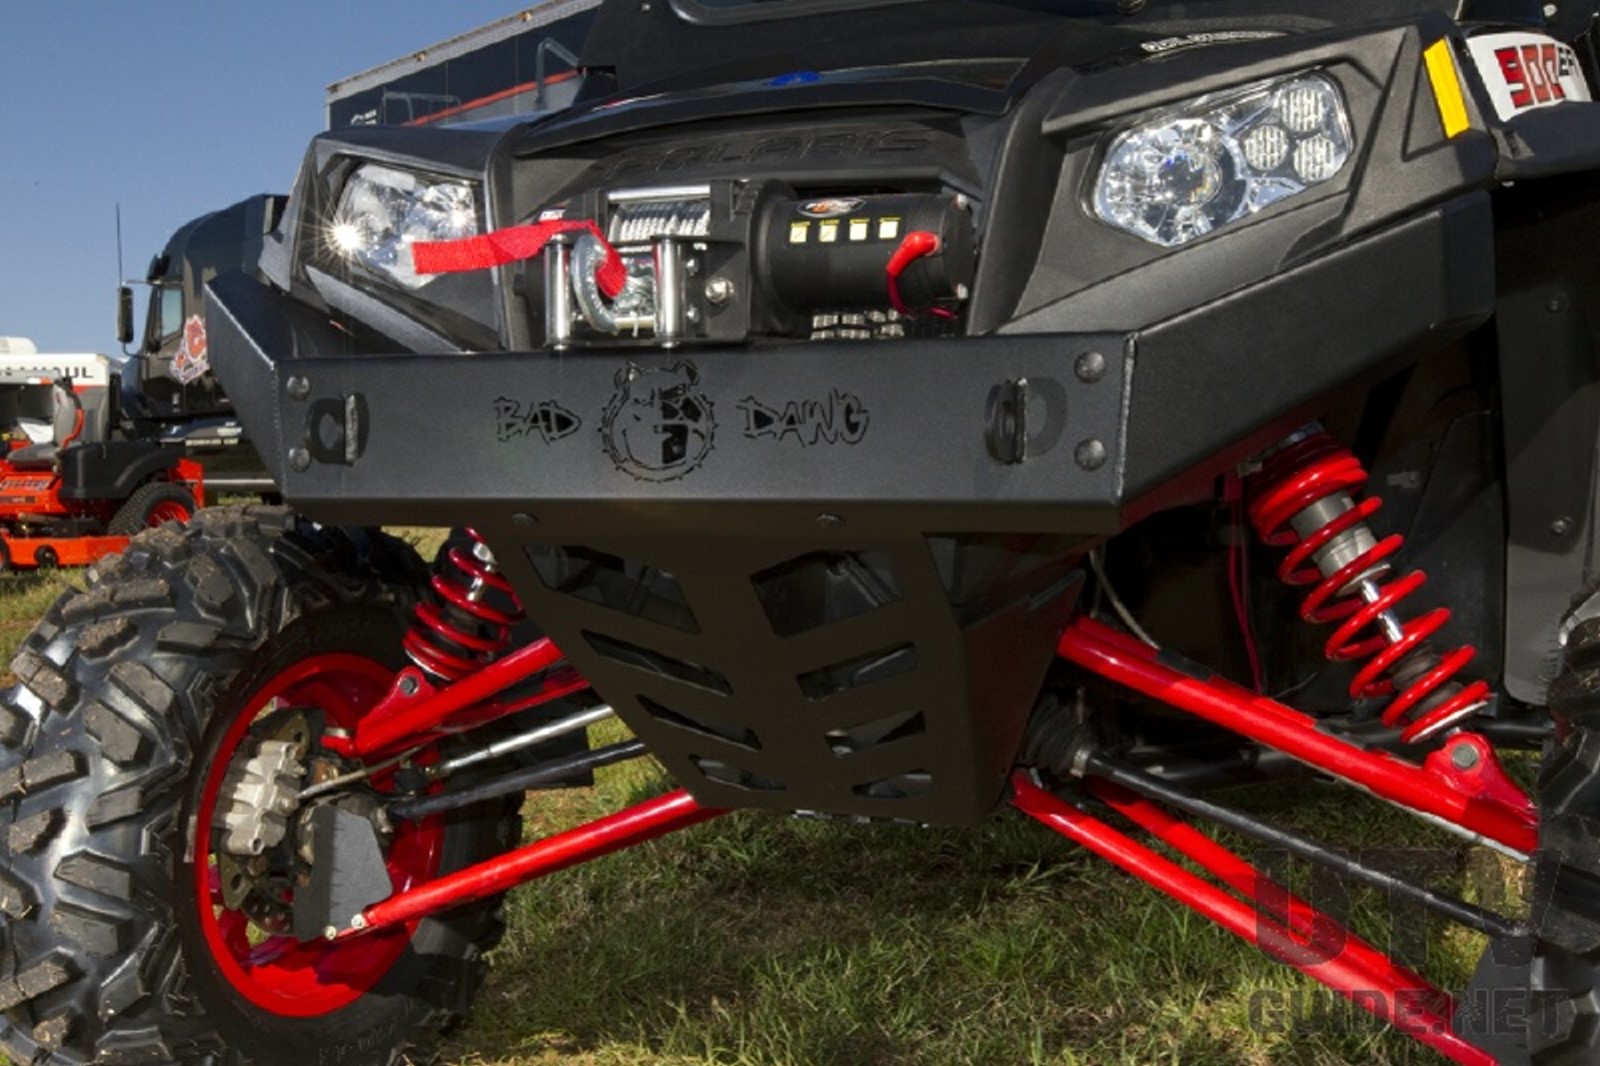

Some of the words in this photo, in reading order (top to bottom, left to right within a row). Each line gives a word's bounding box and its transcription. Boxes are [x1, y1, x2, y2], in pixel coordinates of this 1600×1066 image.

[1494, 43, 1566, 109] 900
[604, 130, 930, 181] POLARIS
[494, 397, 582, 446] BAD
[736, 388, 871, 447] DAWG
